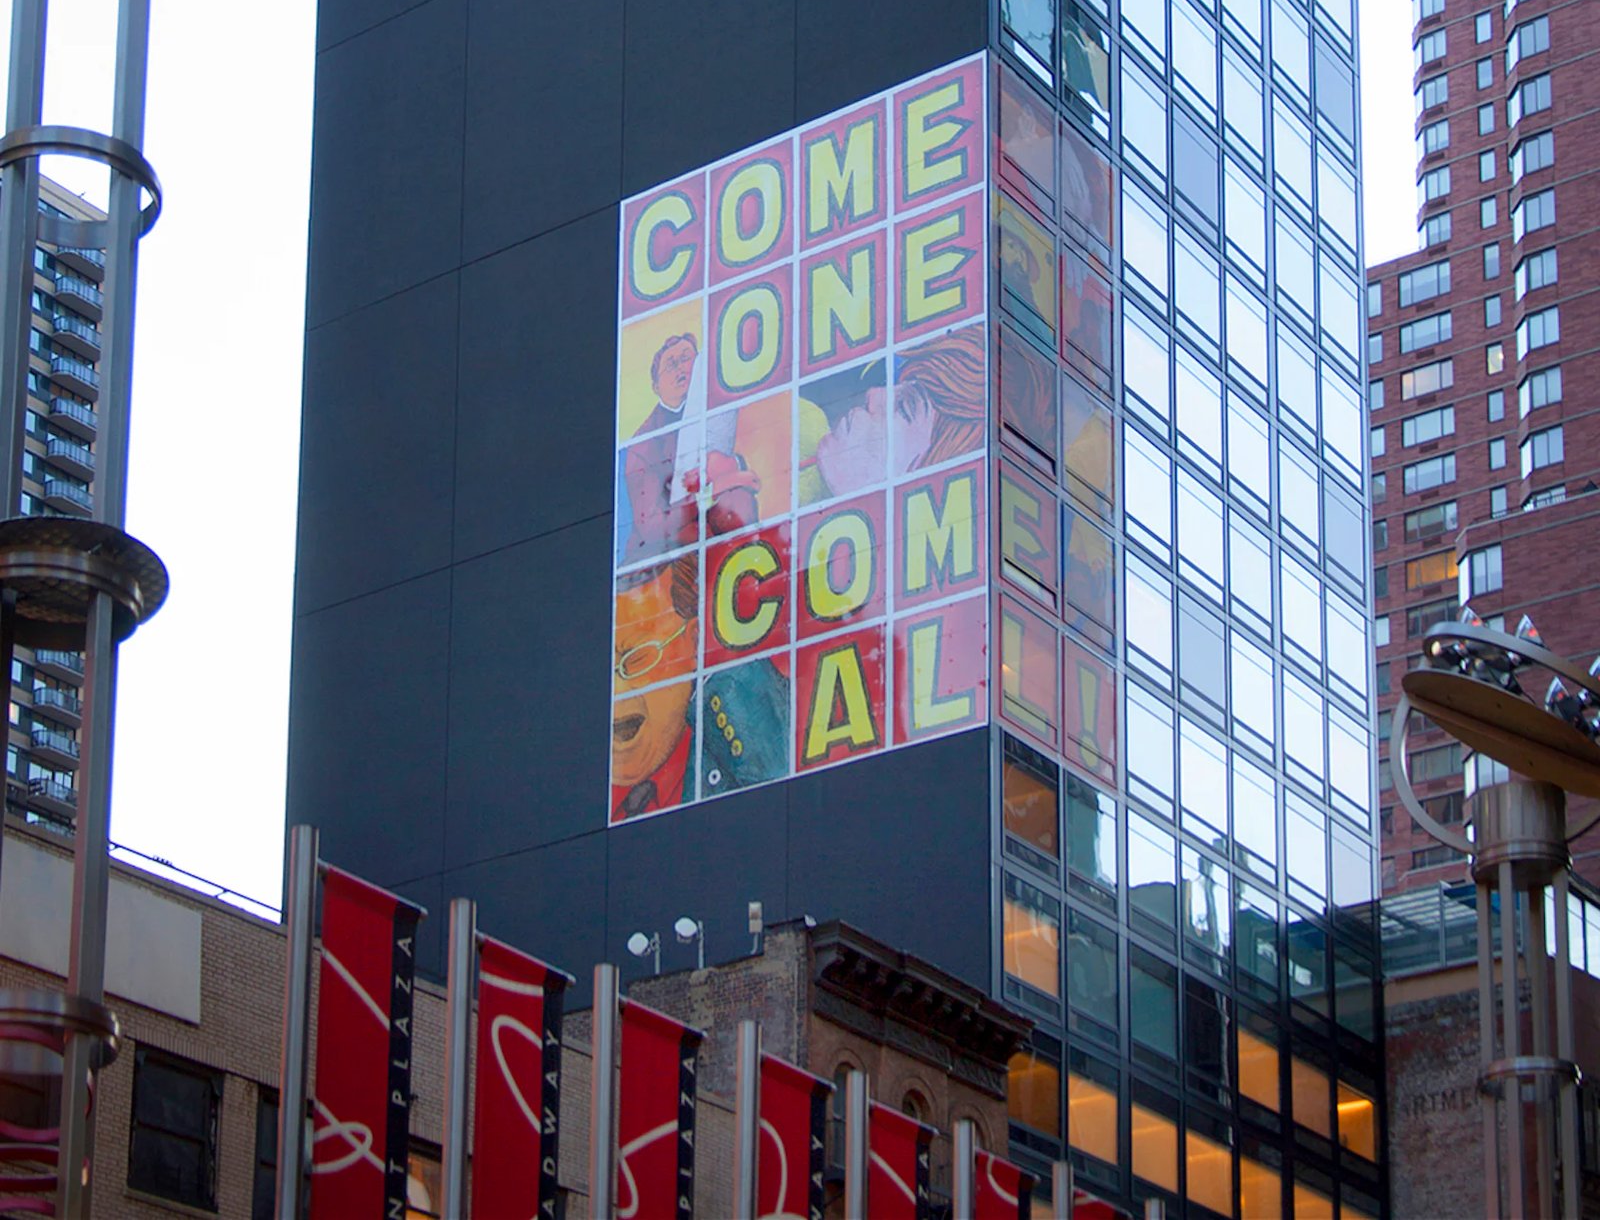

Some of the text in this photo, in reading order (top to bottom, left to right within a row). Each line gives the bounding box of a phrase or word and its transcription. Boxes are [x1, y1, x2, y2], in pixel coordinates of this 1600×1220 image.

[628, 76, 974, 303] COME
[715, 210, 974, 394] ONE
[392, 936, 413, 1107] PLAZA
[680, 1056, 696, 1211] PLAZA
